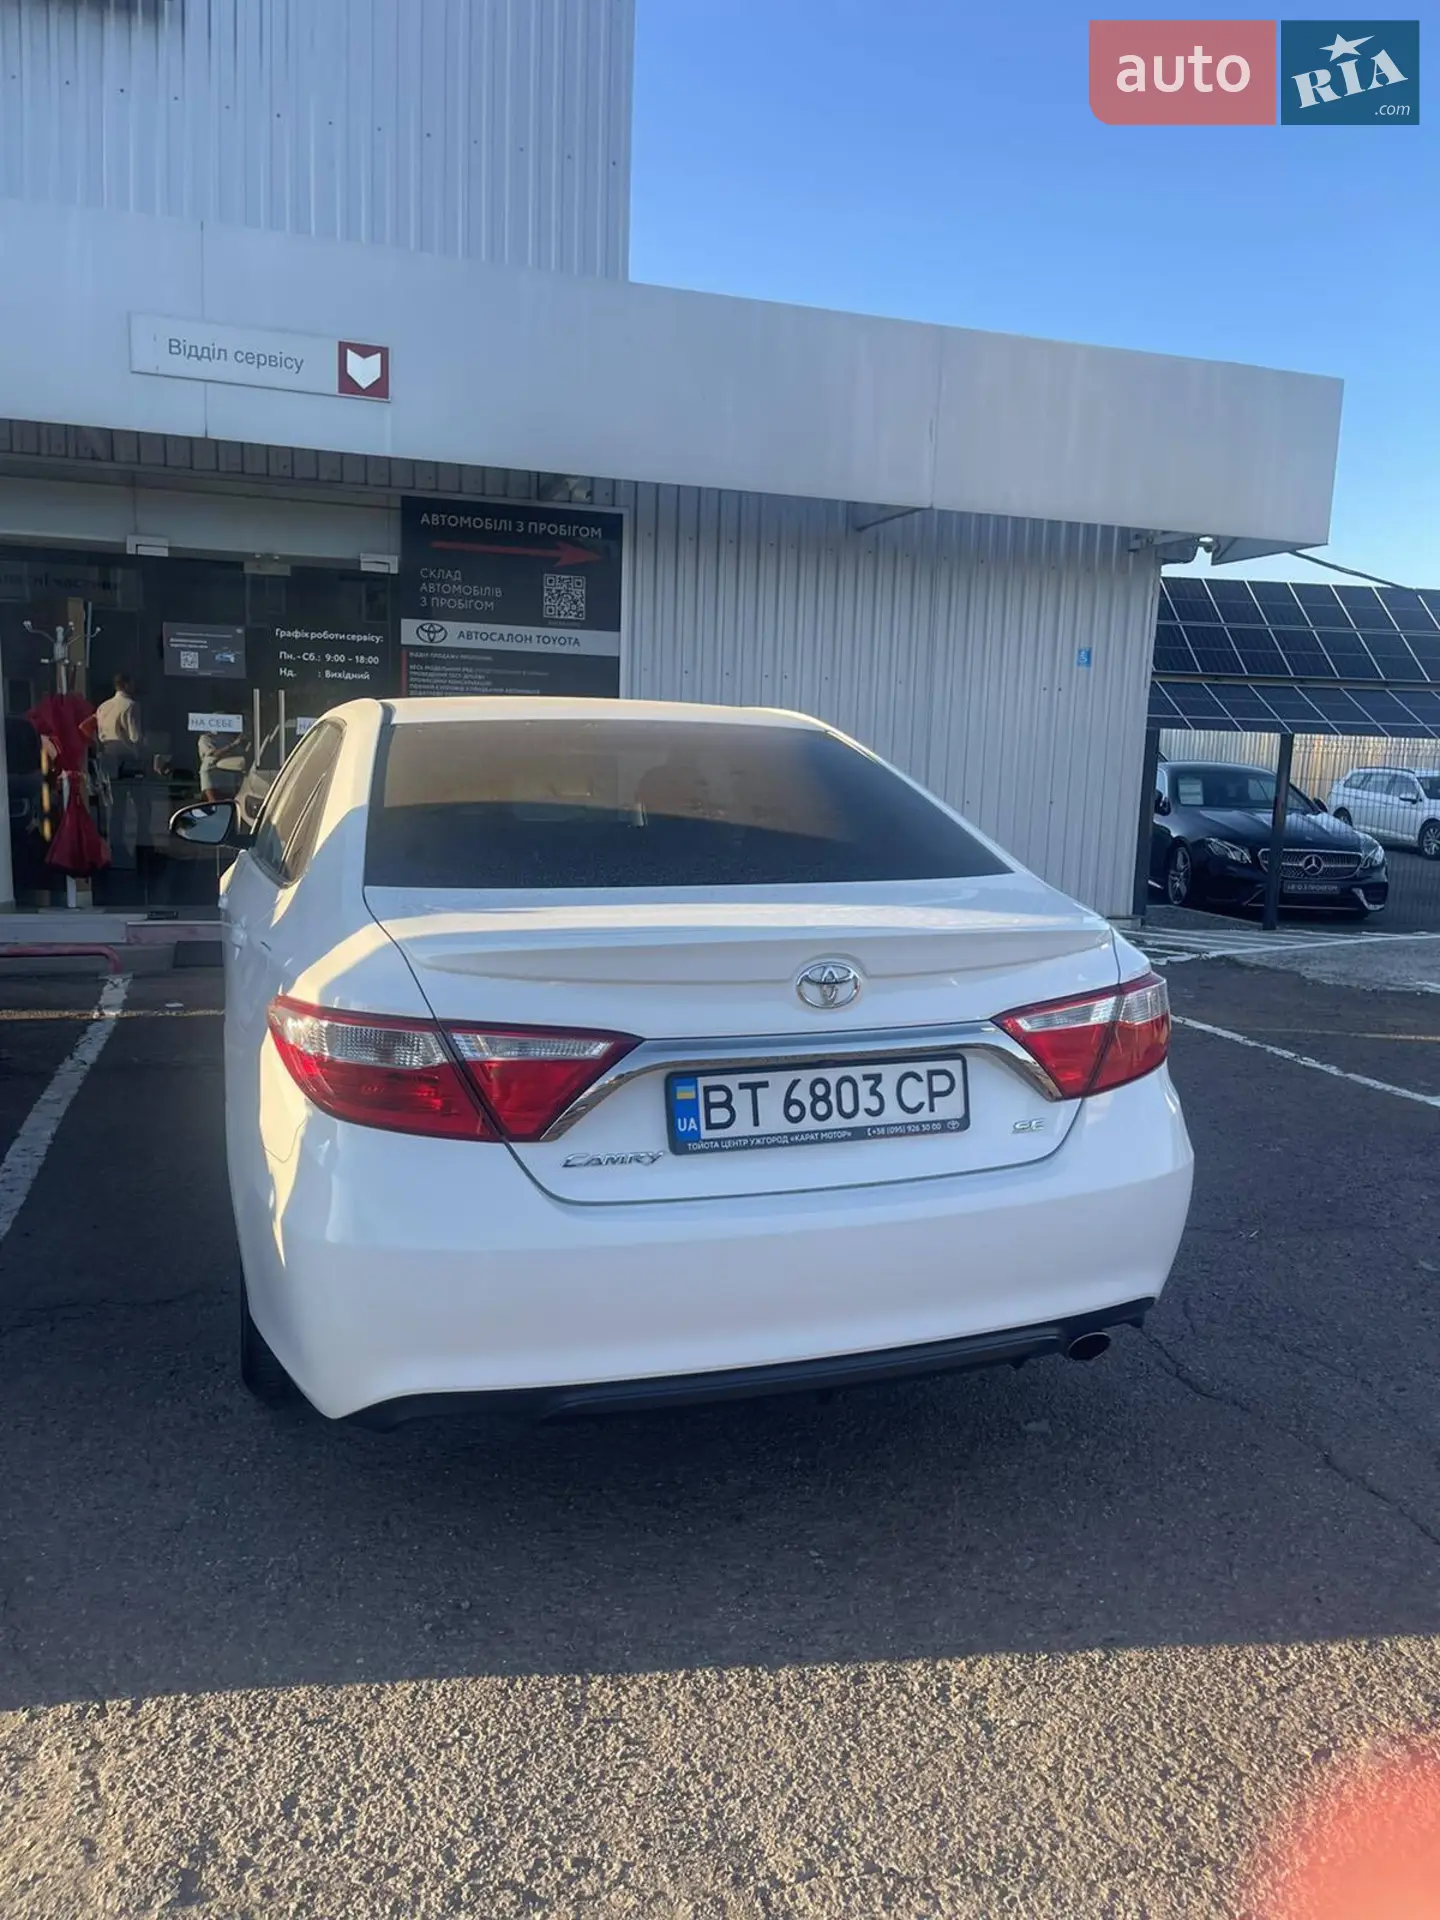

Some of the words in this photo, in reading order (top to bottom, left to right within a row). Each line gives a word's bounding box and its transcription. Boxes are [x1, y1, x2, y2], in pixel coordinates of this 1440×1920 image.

[168, 337, 228, 363] Відділ
[233, 349, 305, 375] сервісу
[420, 513, 512, 533] АВТОМОБІЛІ
[528, 522, 602, 539] ПРОБІГОМ
[420, 567, 462, 582] СКЛАД
[420, 583, 503, 598] АВТОМОБІЛІВ
[431, 597, 495, 612] ПРОБІГОМ
[310, 630, 345, 641] роботи
[457, 630, 533, 645] АВТОСАЛОН
[536, 634, 581, 647] TOYOTA
[325, 653, 346, 663] 9:00
[355, 655, 380, 665] 18:00
[324, 669, 371, 680] Вихідний
[703, 1079, 770, 1131] BT
[782, 1072, 886, 1125] 6803
[895, 1068, 956, 1115] CP
[677, 1116, 698, 1132] UA
[687, 1141, 719, 1151] ТОЙОТА
[720, 1139, 749, 1149] ЦЕНТР
[750, 1136, 789, 1147] УЖГОРОД
[562, 1150, 664, 1167] CAMRY
